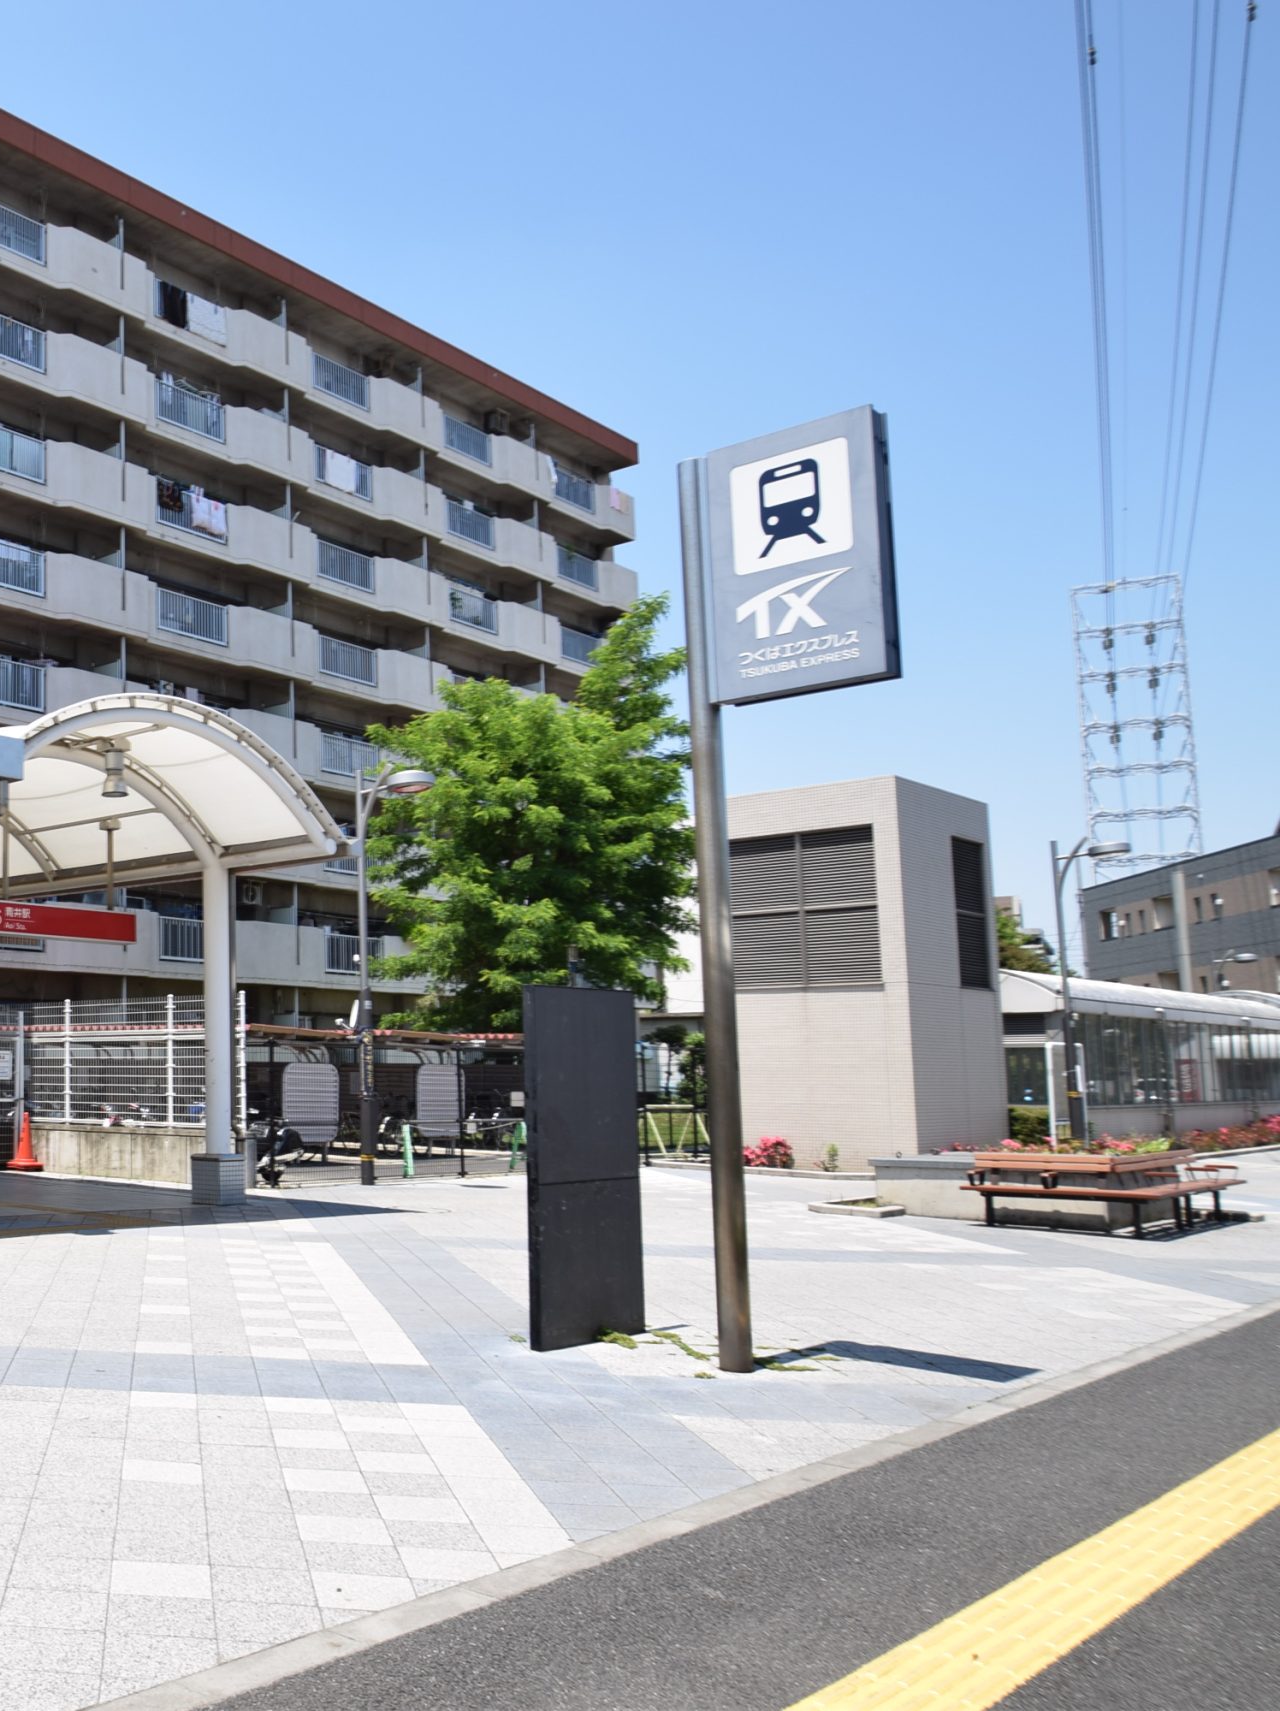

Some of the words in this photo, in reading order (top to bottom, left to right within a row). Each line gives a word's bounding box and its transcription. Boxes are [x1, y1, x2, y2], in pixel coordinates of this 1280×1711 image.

[736, 566, 854, 640] TX
[738, 659, 799, 679] TSUKUBA
[799, 647, 861, 668] EXPRESS
